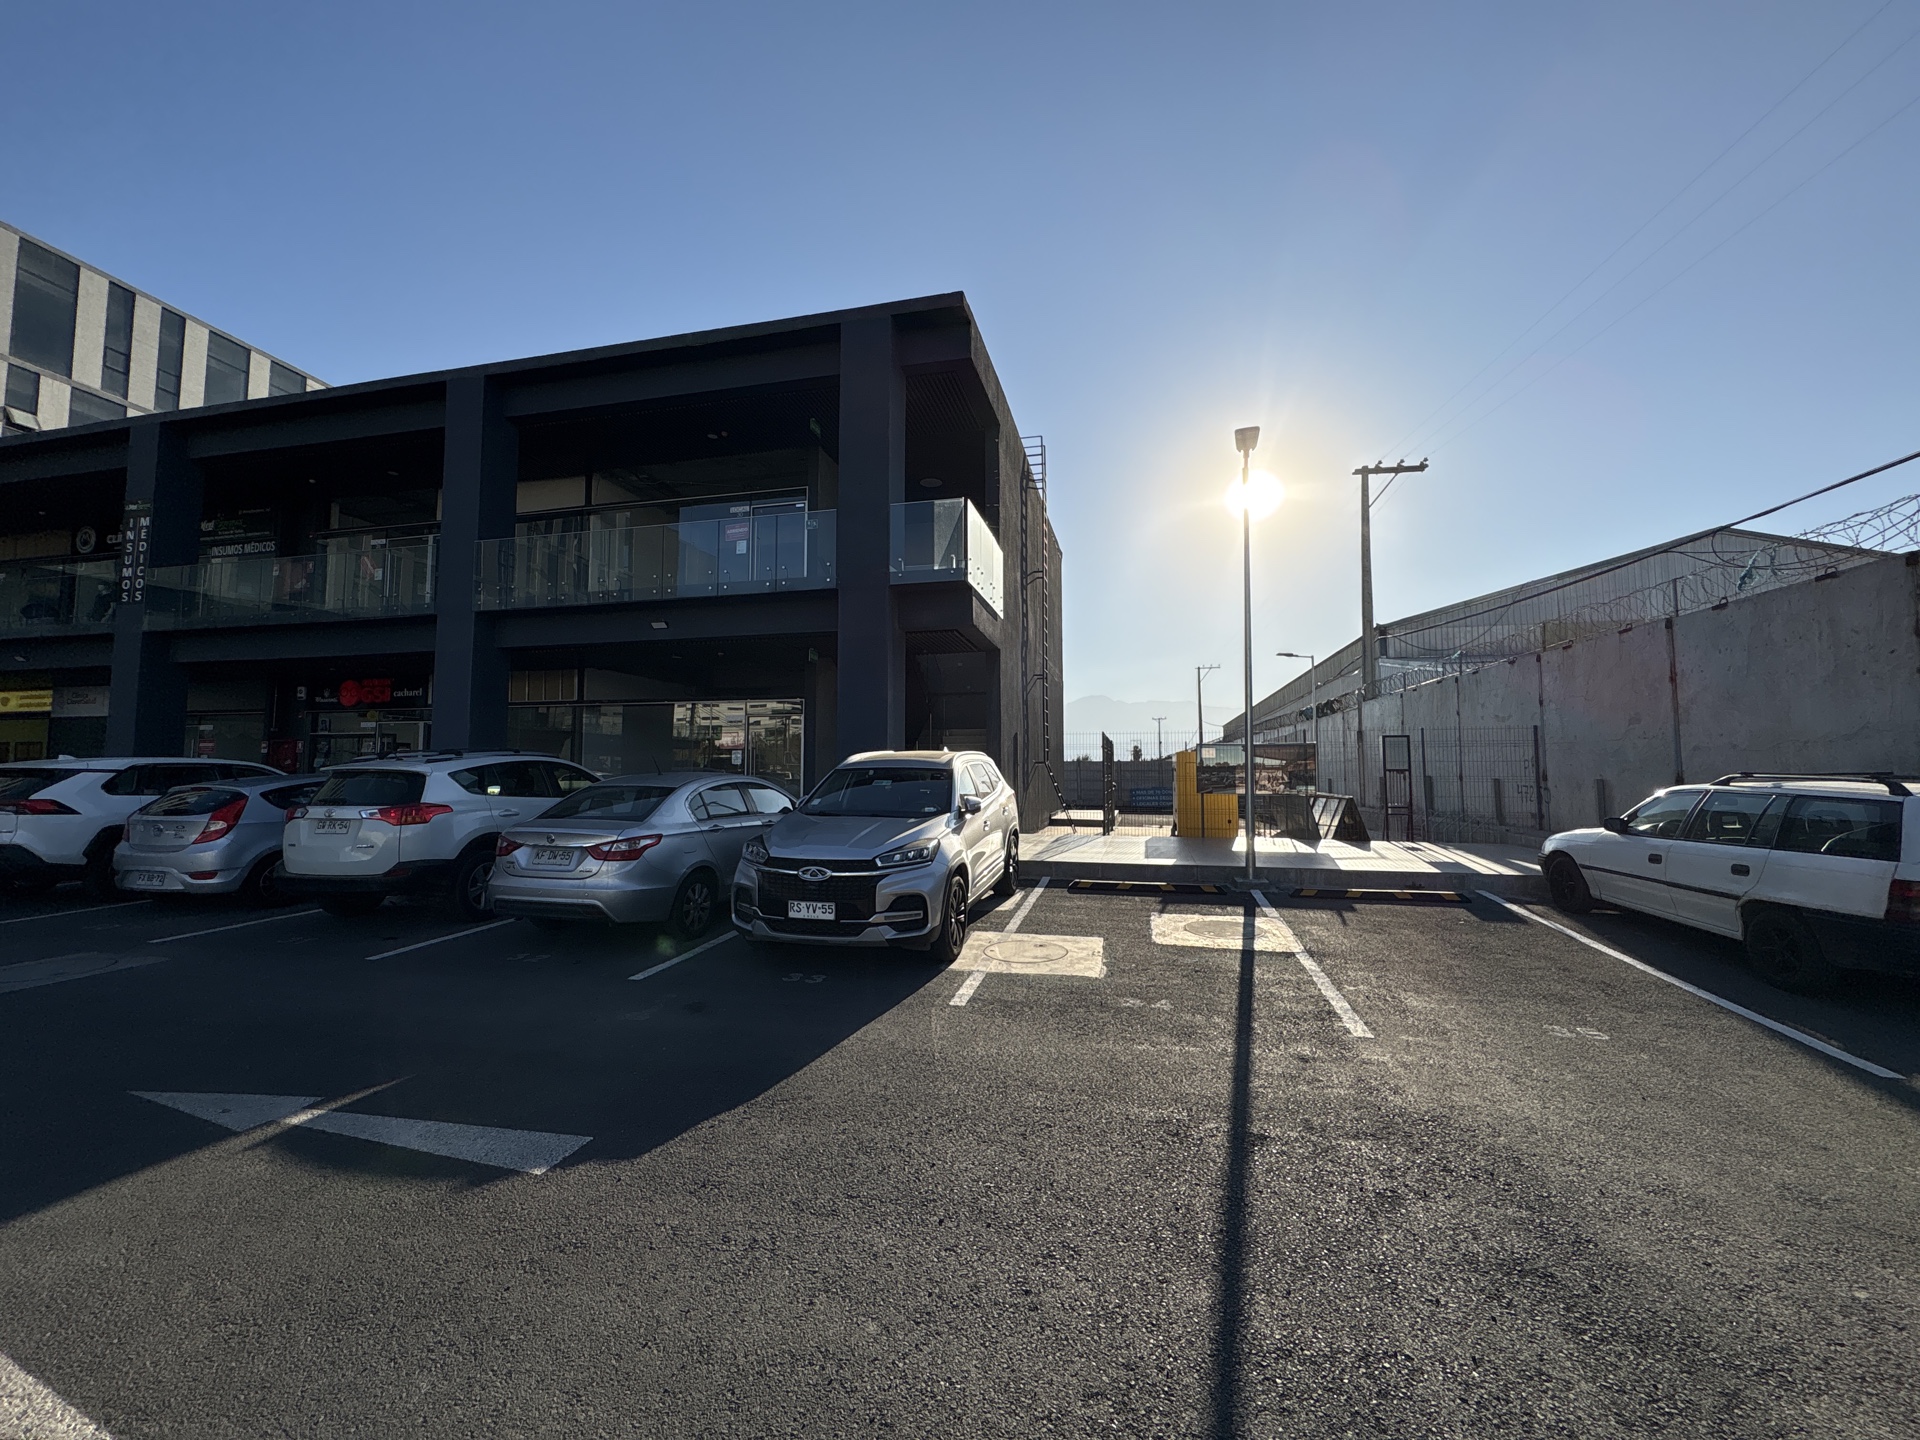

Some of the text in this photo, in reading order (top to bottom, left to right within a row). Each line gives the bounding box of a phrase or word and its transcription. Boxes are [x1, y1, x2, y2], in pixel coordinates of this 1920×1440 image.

[211, 540, 277, 557] INSUMOS MÉDICOS
[121, 518, 135, 602] INSUMOS
[135, 516, 150, 601] MÉDICOS
[393, 688, 423, 697] cacharel
[781, 972, 828, 984] 33
